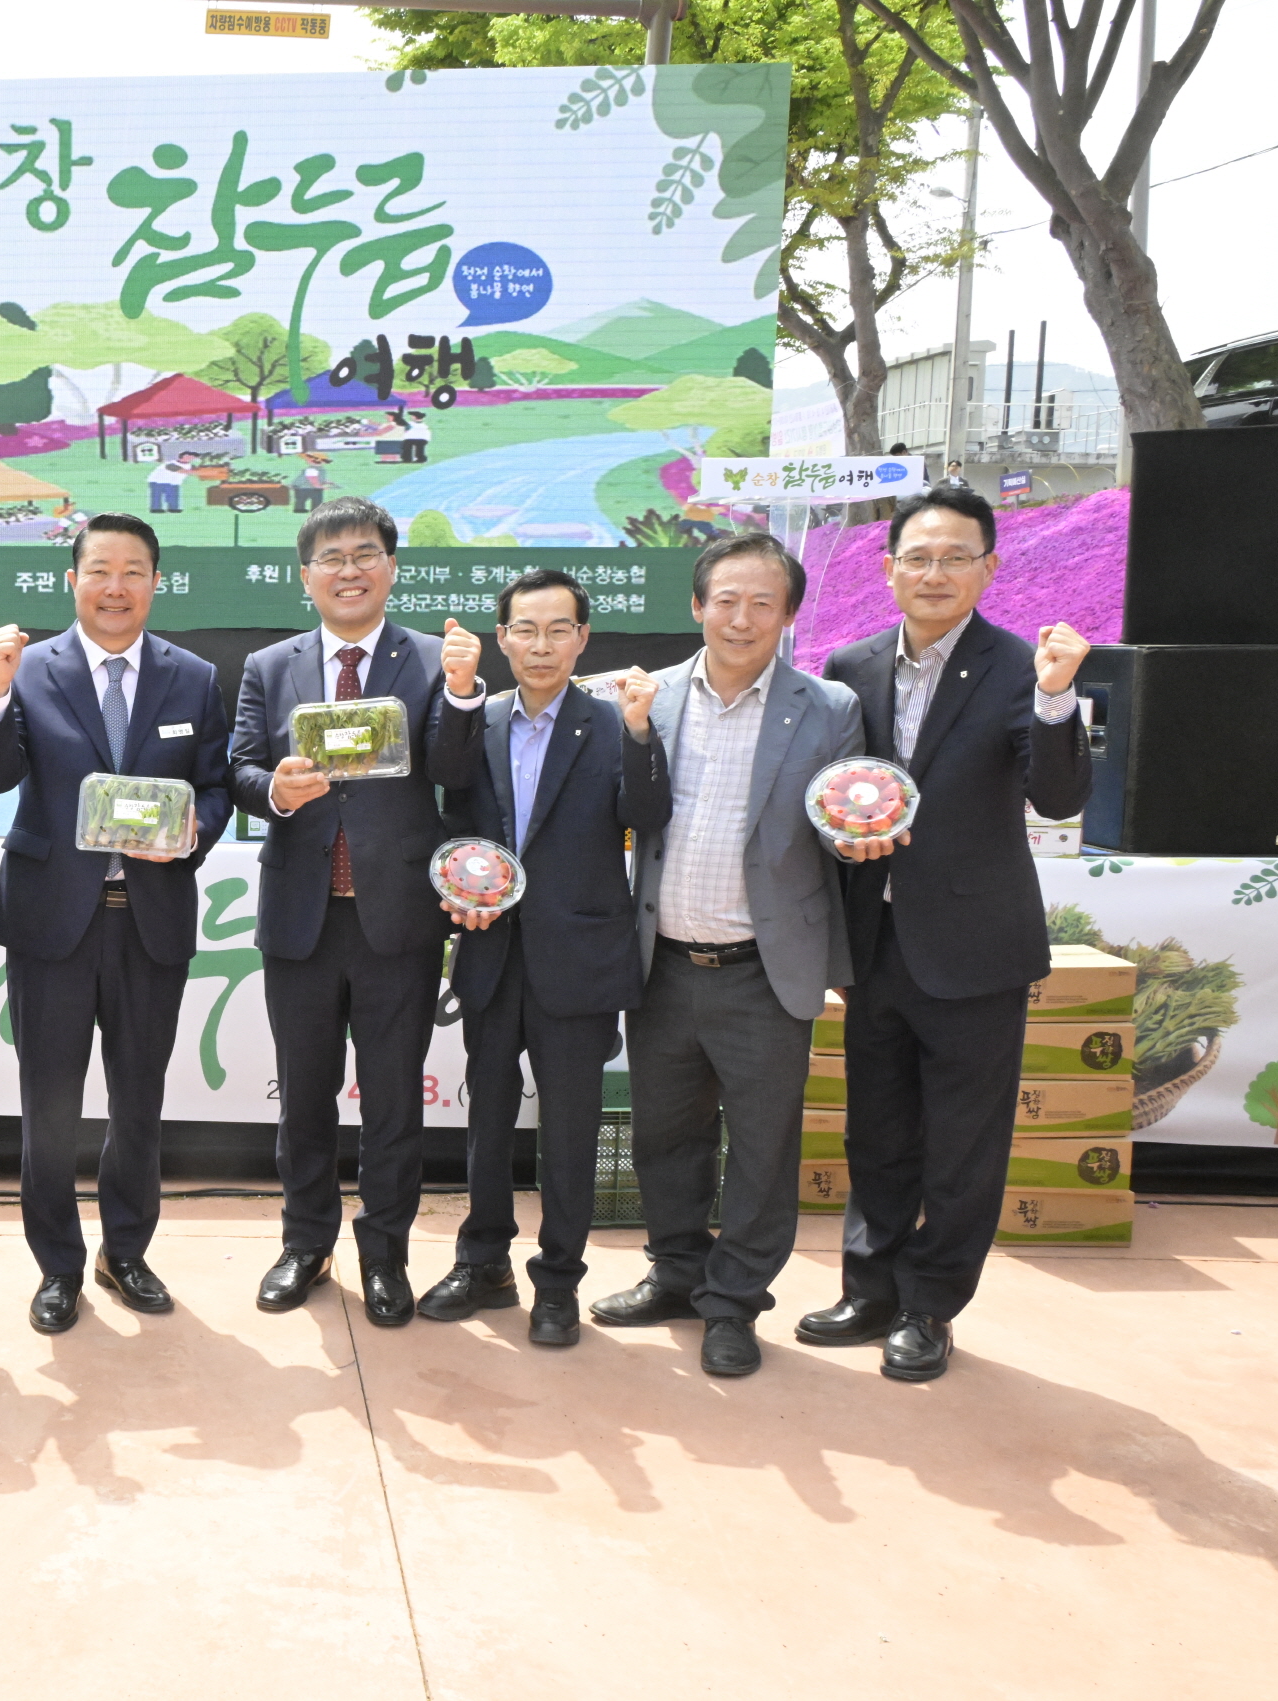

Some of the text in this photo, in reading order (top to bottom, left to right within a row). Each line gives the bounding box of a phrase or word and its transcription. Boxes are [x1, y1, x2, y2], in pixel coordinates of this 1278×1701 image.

[209, 14, 327, 35] 차량침수예방용 CCTV 작동중
[107, 130, 454, 404] 참두릅
[493, 264, 543, 281] 순창에서
[329, 334, 476, 409] 여행
[751, 472, 780, 487] 순창
[838, 470, 873, 488] 여행
[15, 572, 56, 593] 주관
[245, 564, 279, 583] 후원
